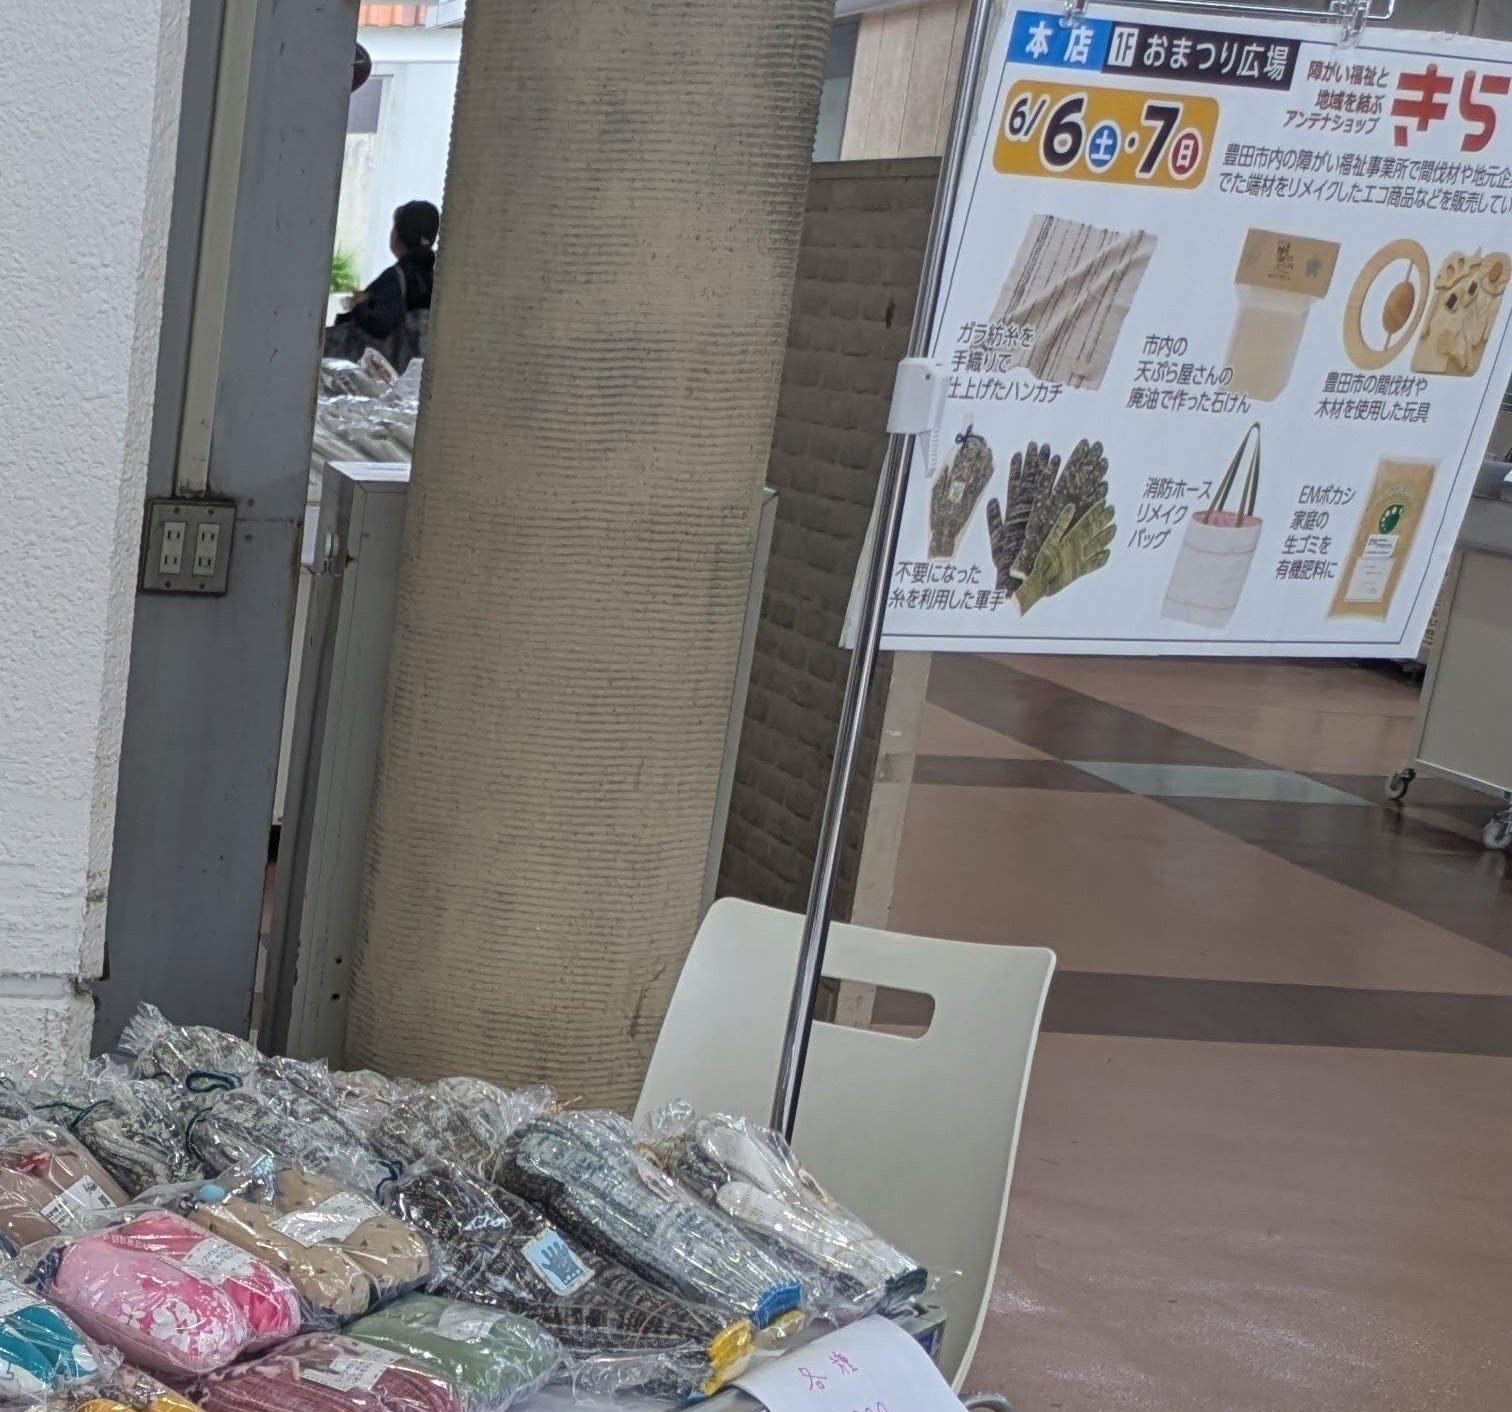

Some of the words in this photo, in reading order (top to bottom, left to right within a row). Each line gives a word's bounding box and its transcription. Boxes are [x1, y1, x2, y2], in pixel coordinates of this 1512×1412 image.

[1027, 21, 1094, 64] 本店
[1144, 34, 1289, 81] おまつり広場
[1306, 60, 1391, 88] 障がい福祉と
[1314, 88, 1386, 114] 地域を結ぶ
[1282, 109, 1380, 135] アンテナショップ
[956, 322, 1034, 349] ガラ紡糸を
[1141, 334, 1188, 357] 市内の
[951, 350, 1011, 374] 手織りで
[1133, 360, 1234, 386] 天ぷら屋さんの
[1321, 372, 1428, 397] 豊田市の間伐材や
[1127, 387, 1251, 414] 廃油で作った石けん
[1314, 400, 1430, 424] 木材を使用した玩具
[1142, 476, 1214, 500] 消防ホース
[1298, 485, 1356, 505] EMボカシ
[1136, 503, 1189, 525] リメイク
[1290, 510, 1329, 530] 家庭の
[1127, 528, 1171, 550] バッグ
[1282, 534, 1332, 556] 生ゴミを
[894, 561, 982, 585] 不要になった
[1276, 559, 1338, 581] 有機肥料に
[888, 588, 1006, 612] 糸を利用した軍手
